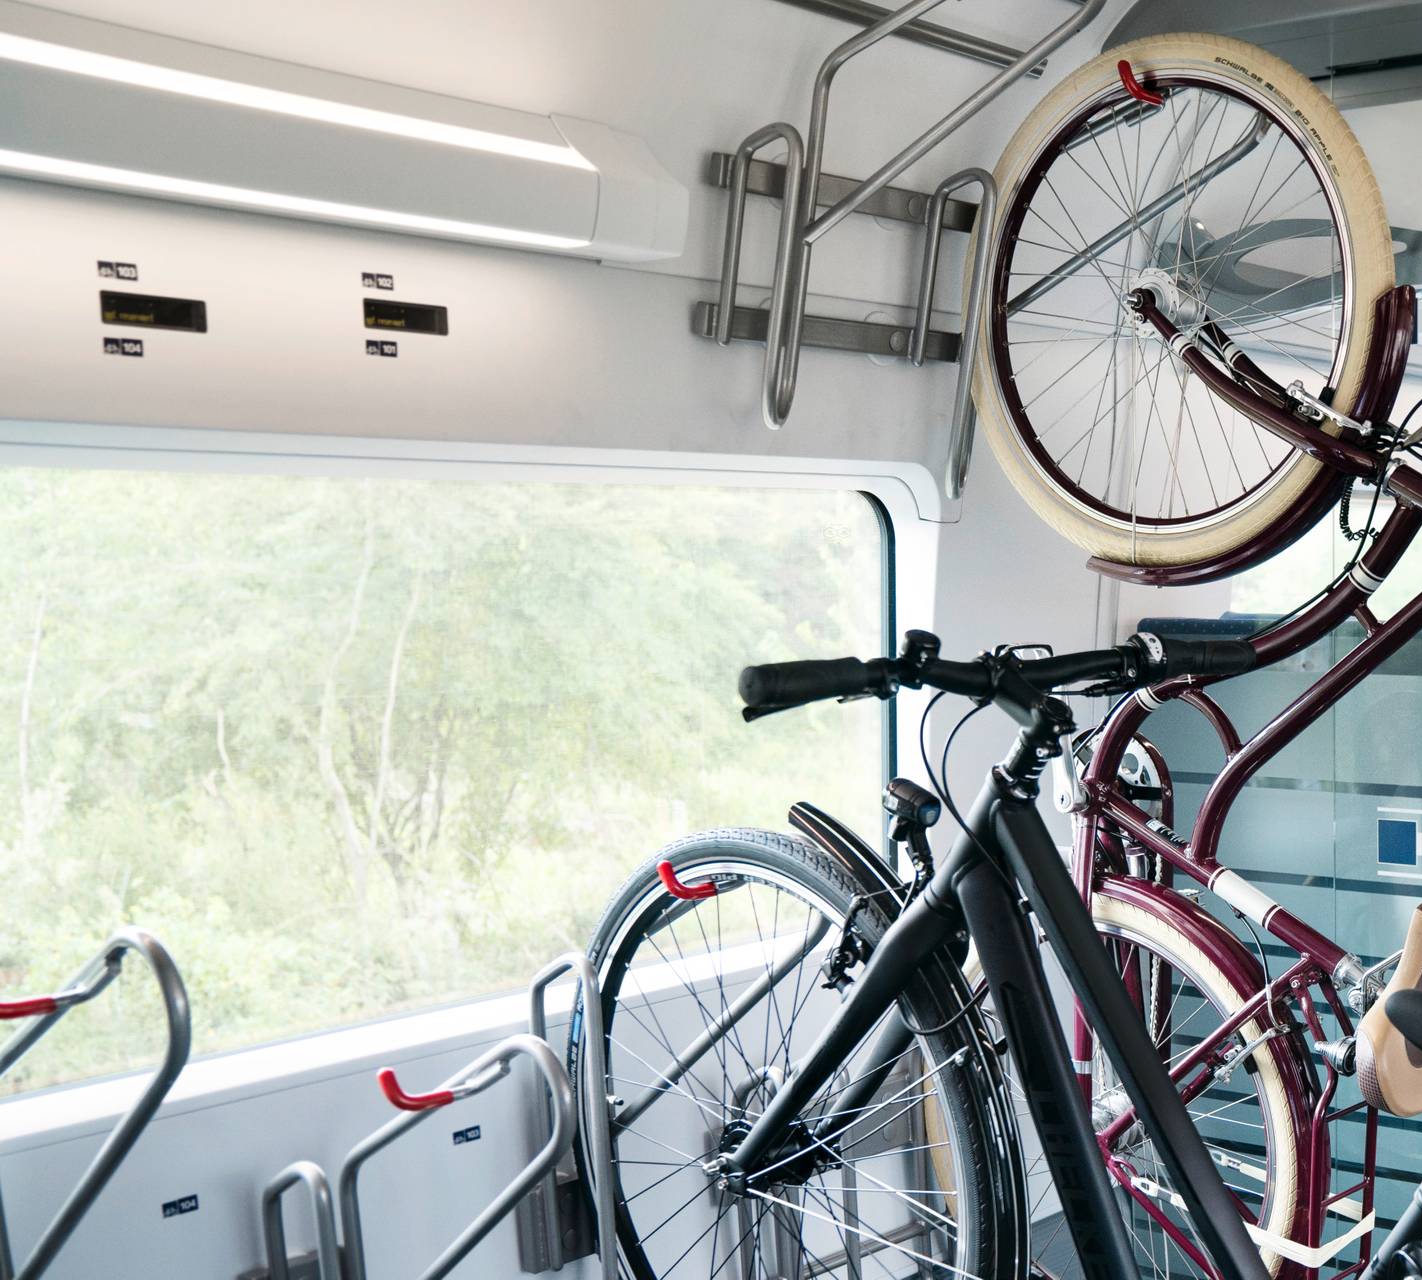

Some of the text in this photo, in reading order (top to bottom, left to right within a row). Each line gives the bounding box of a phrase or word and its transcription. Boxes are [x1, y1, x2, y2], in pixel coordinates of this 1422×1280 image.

[1213, 56, 1334, 162] SCHWALBE BIG APPLE
[117, 265, 137, 279] 103
[377, 277, 393, 289] 102
[123, 342, 142, 354] 104
[382, 344, 397, 355] 101
[180, 1198, 196, 1211] 104
